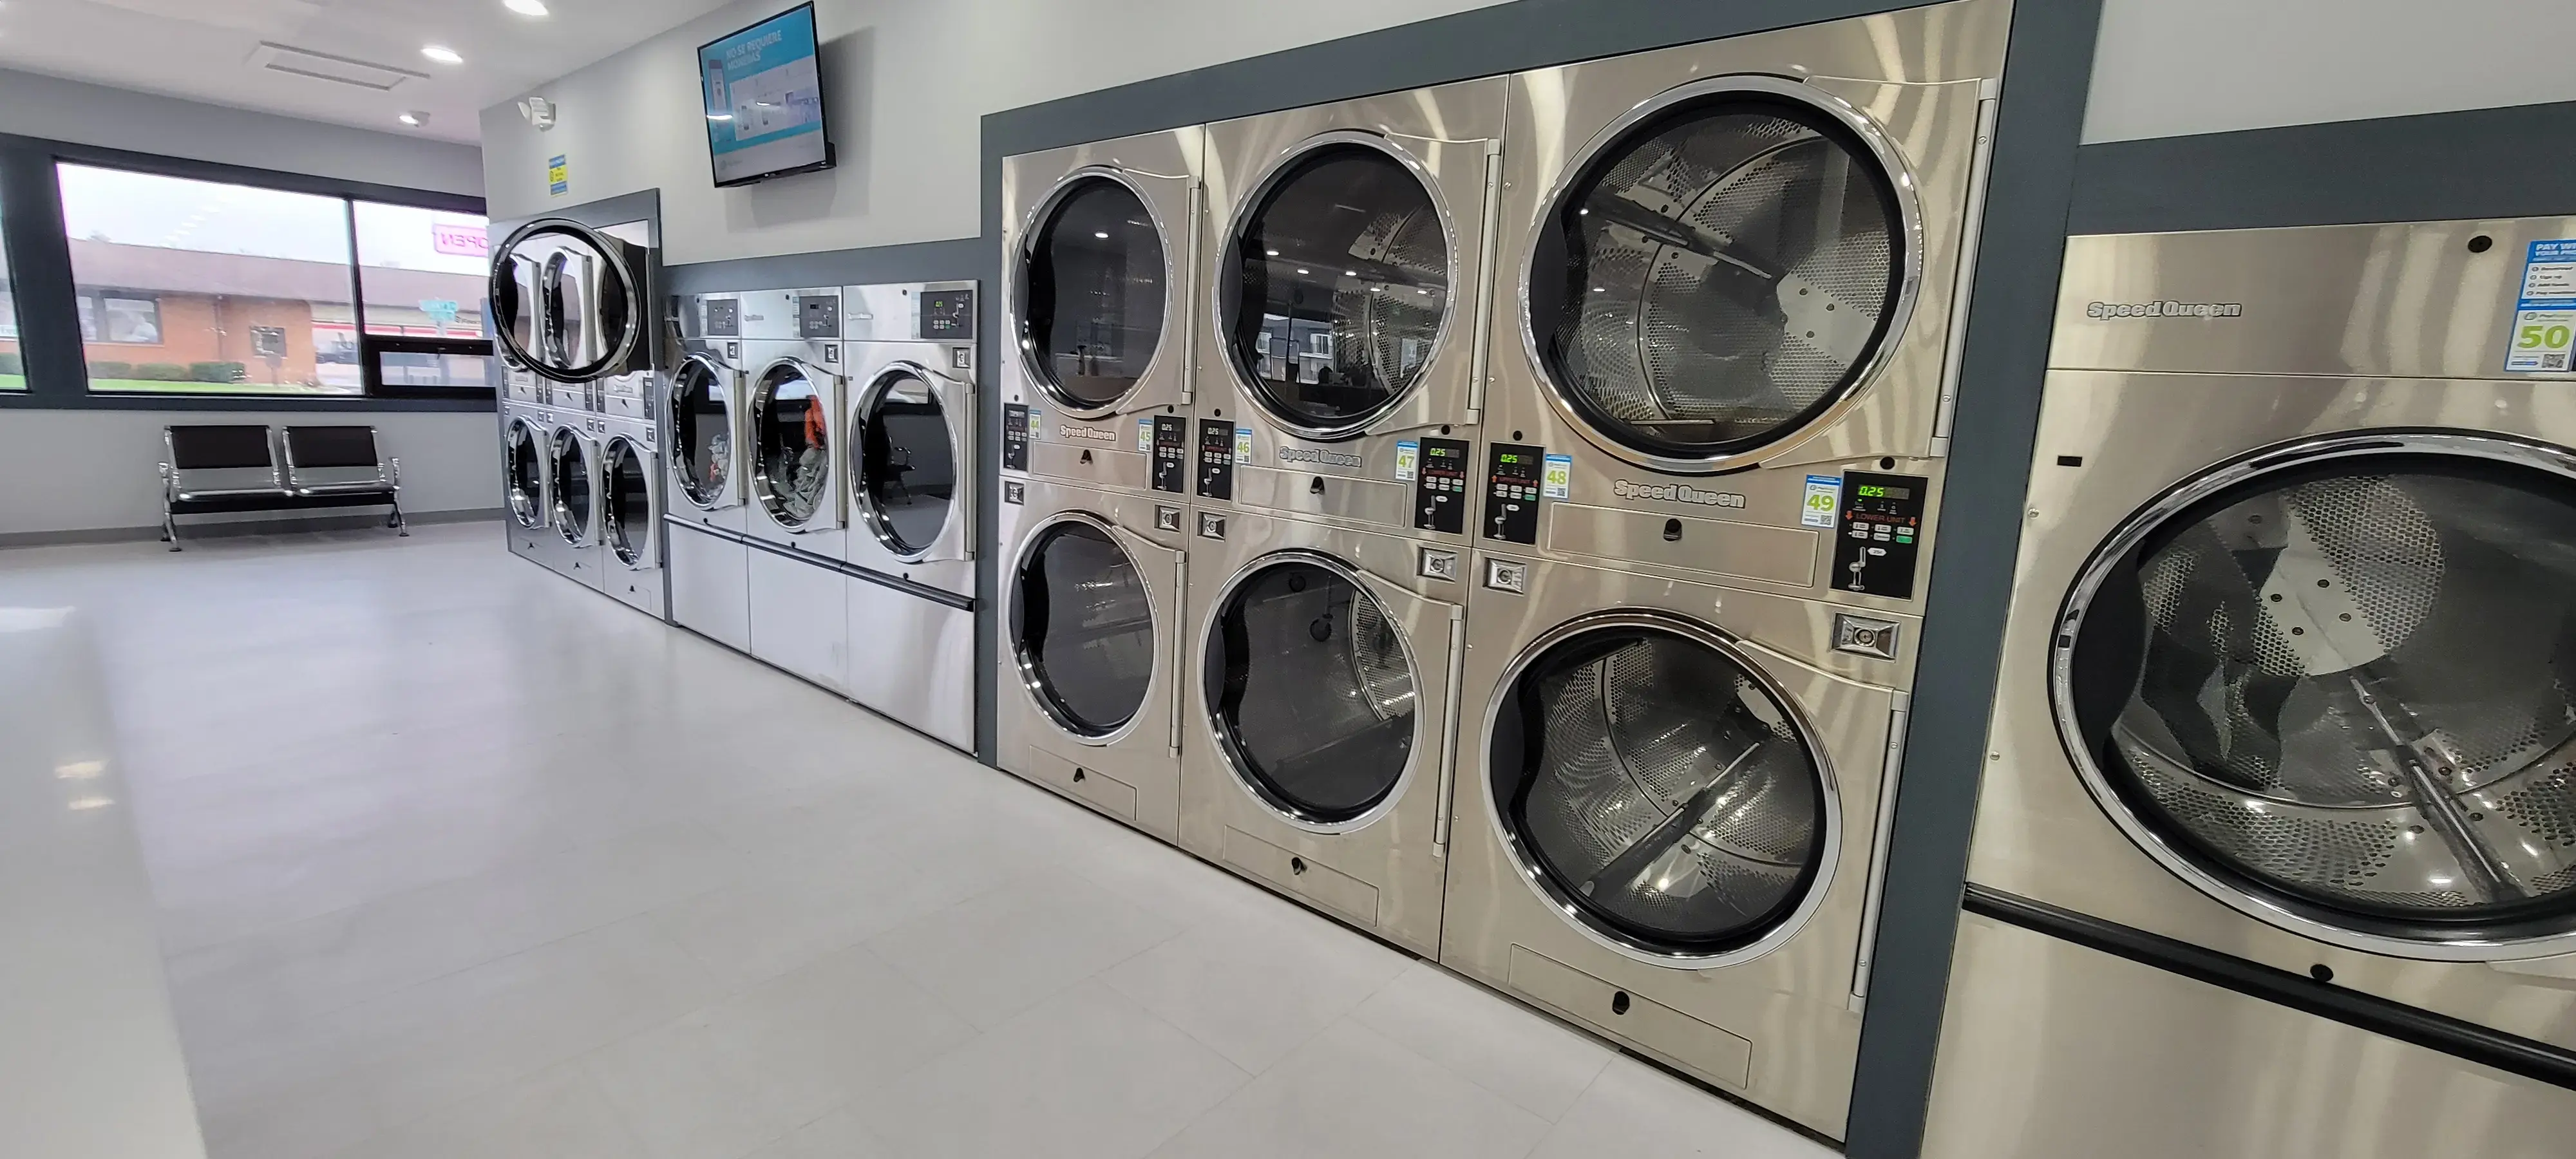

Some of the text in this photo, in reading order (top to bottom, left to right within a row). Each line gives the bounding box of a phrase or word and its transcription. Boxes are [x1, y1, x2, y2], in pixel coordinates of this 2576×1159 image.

[2087, 300, 2242, 321] Speed Queen
[2517, 325, 2570, 349] 50
[1059, 424, 1117, 442] Speed Queen
[1140, 431, 1151, 442] 45
[1236, 442, 1250, 453] 46
[1279, 446, 1363, 468] Speed Queen
[1398, 455, 1415, 469] 47
[1547, 470, 1567, 485] 48
[1614, 479, 1747, 509] Speed Queen
[1806, 494, 1834, 512] 49
[1855, 513, 1885, 522] LOWER
